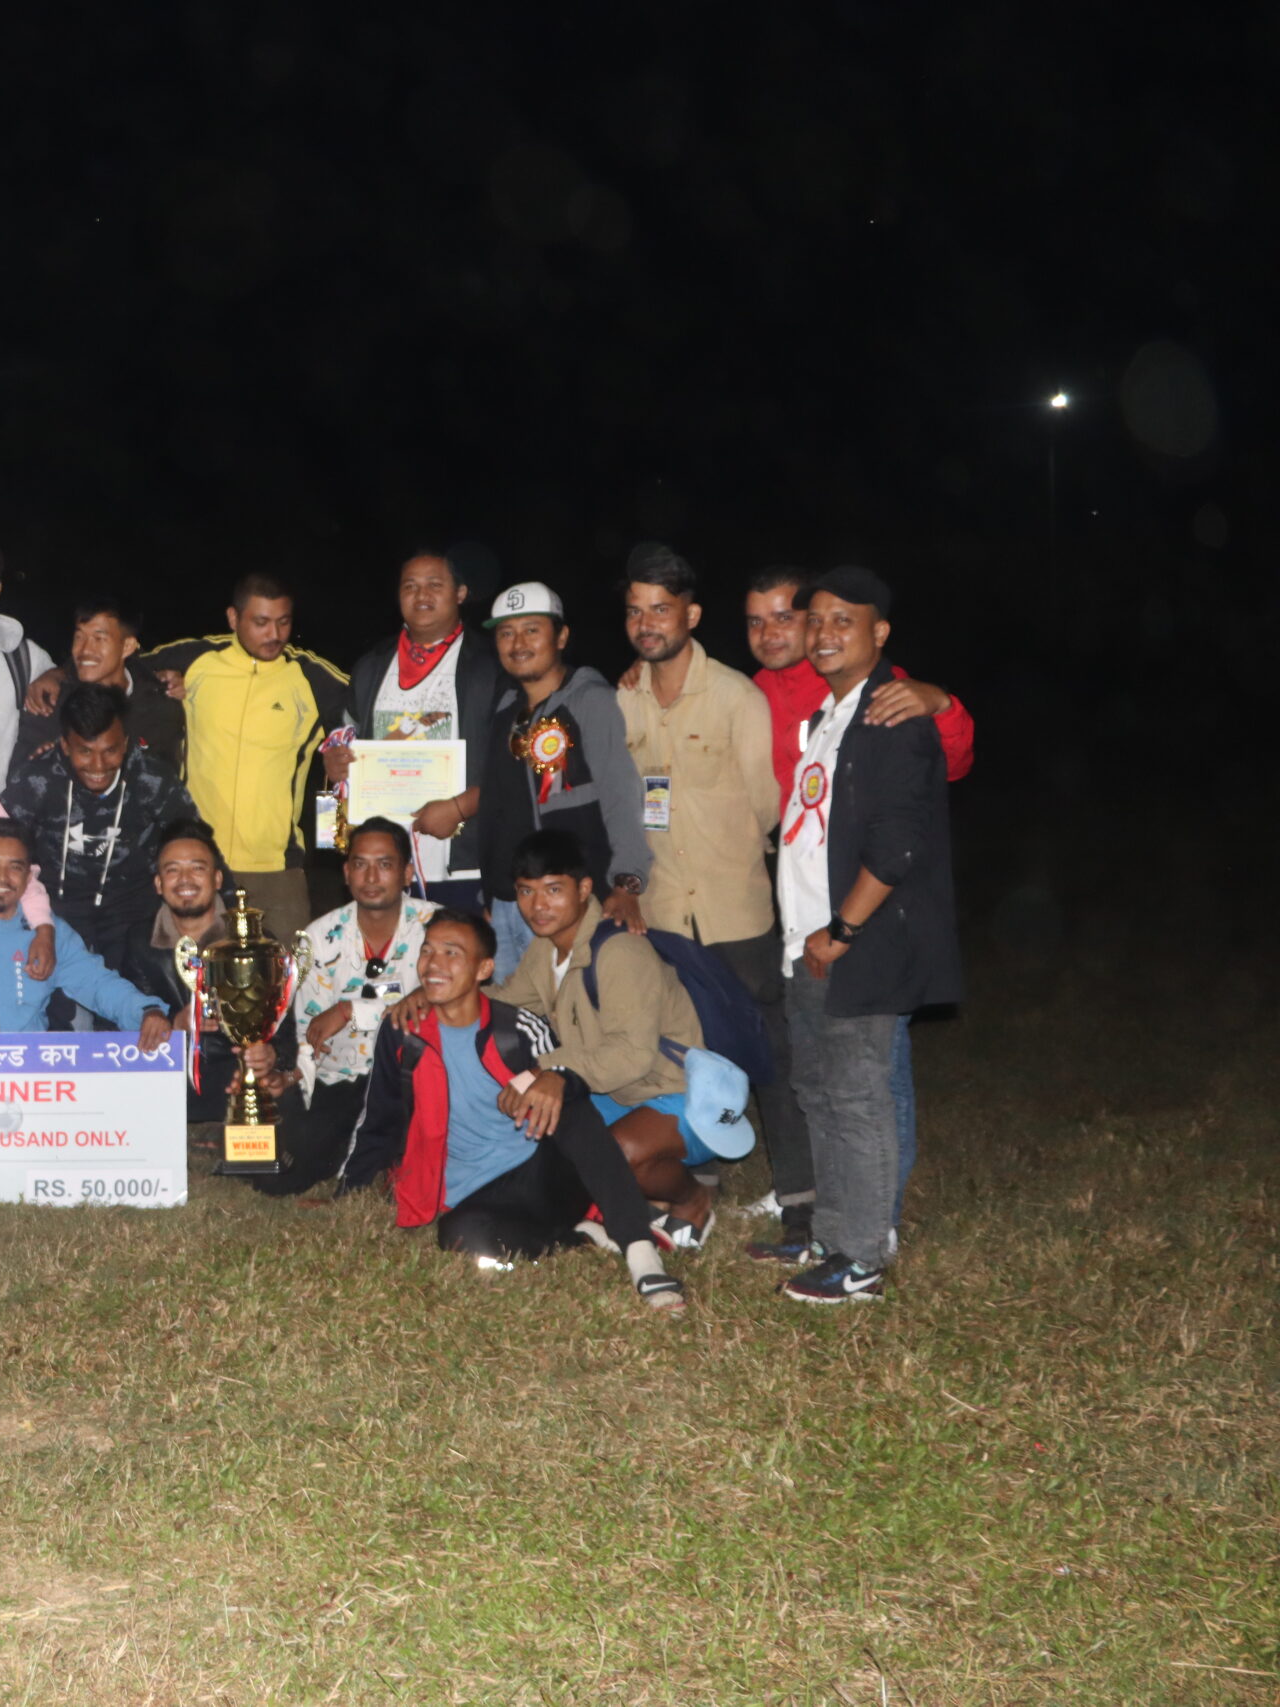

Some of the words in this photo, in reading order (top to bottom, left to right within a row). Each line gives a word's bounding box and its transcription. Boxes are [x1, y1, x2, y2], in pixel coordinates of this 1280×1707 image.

[38, 1044, 80, 1067] कप
[74, 1130, 131, 1147] ONLY.
[33, 1179, 73, 1198] RS.
[80, 1177, 169, 1200] 50,000/-
